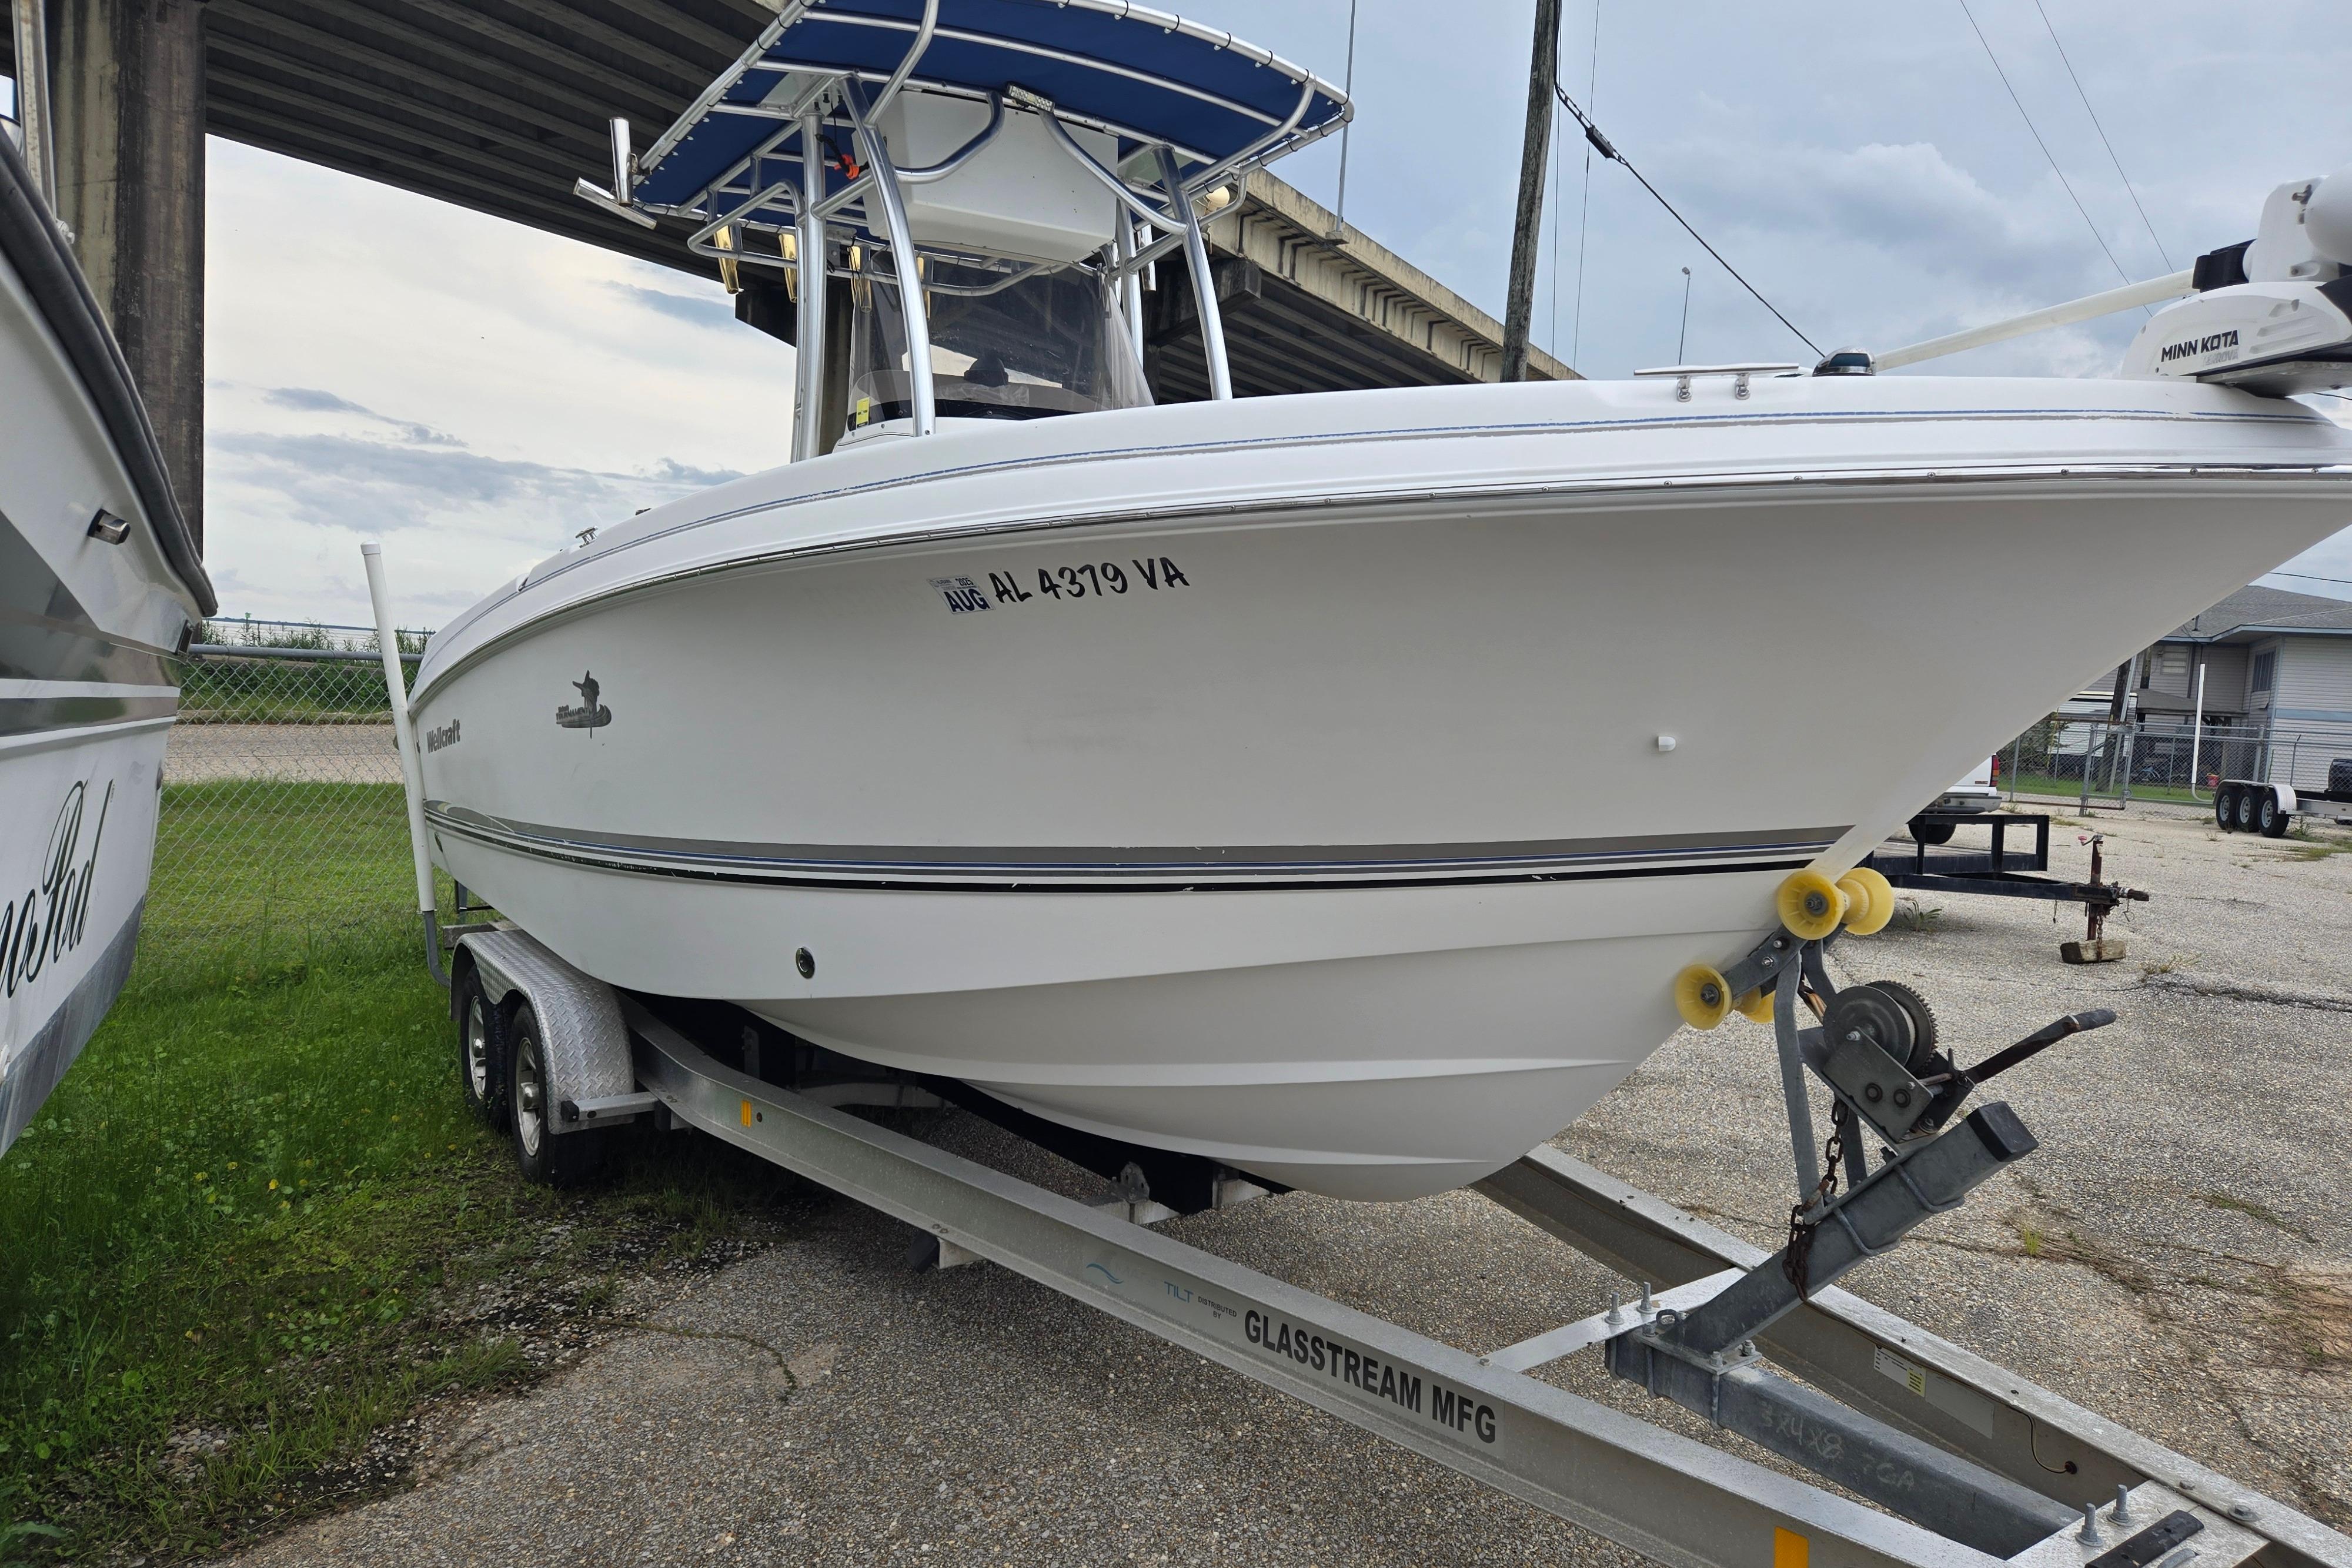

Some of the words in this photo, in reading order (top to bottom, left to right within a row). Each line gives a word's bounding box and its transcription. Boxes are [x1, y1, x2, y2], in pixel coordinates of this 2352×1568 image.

[2161, 339, 2199, 362] MINN
[2200, 329, 2239, 353] KOTA
[955, 577, 974, 586] 2025
[988, 570, 1033, 603] AL
[1038, 562, 1128, 600] 4379
[1131, 557, 1190, 590] VA
[943, 589, 991, 612] AUG
[427, 718, 460, 754] Wellcraft
[1164, 1281, 1194, 1303] TILT
[1198, 1295, 1237, 1318] DISTRIBUTED
[1212, 1310, 1222, 1319] BY
[1245, 1309, 1421, 1414] GLASSTREAM
[1432, 1384, 1496, 1444] MFG
